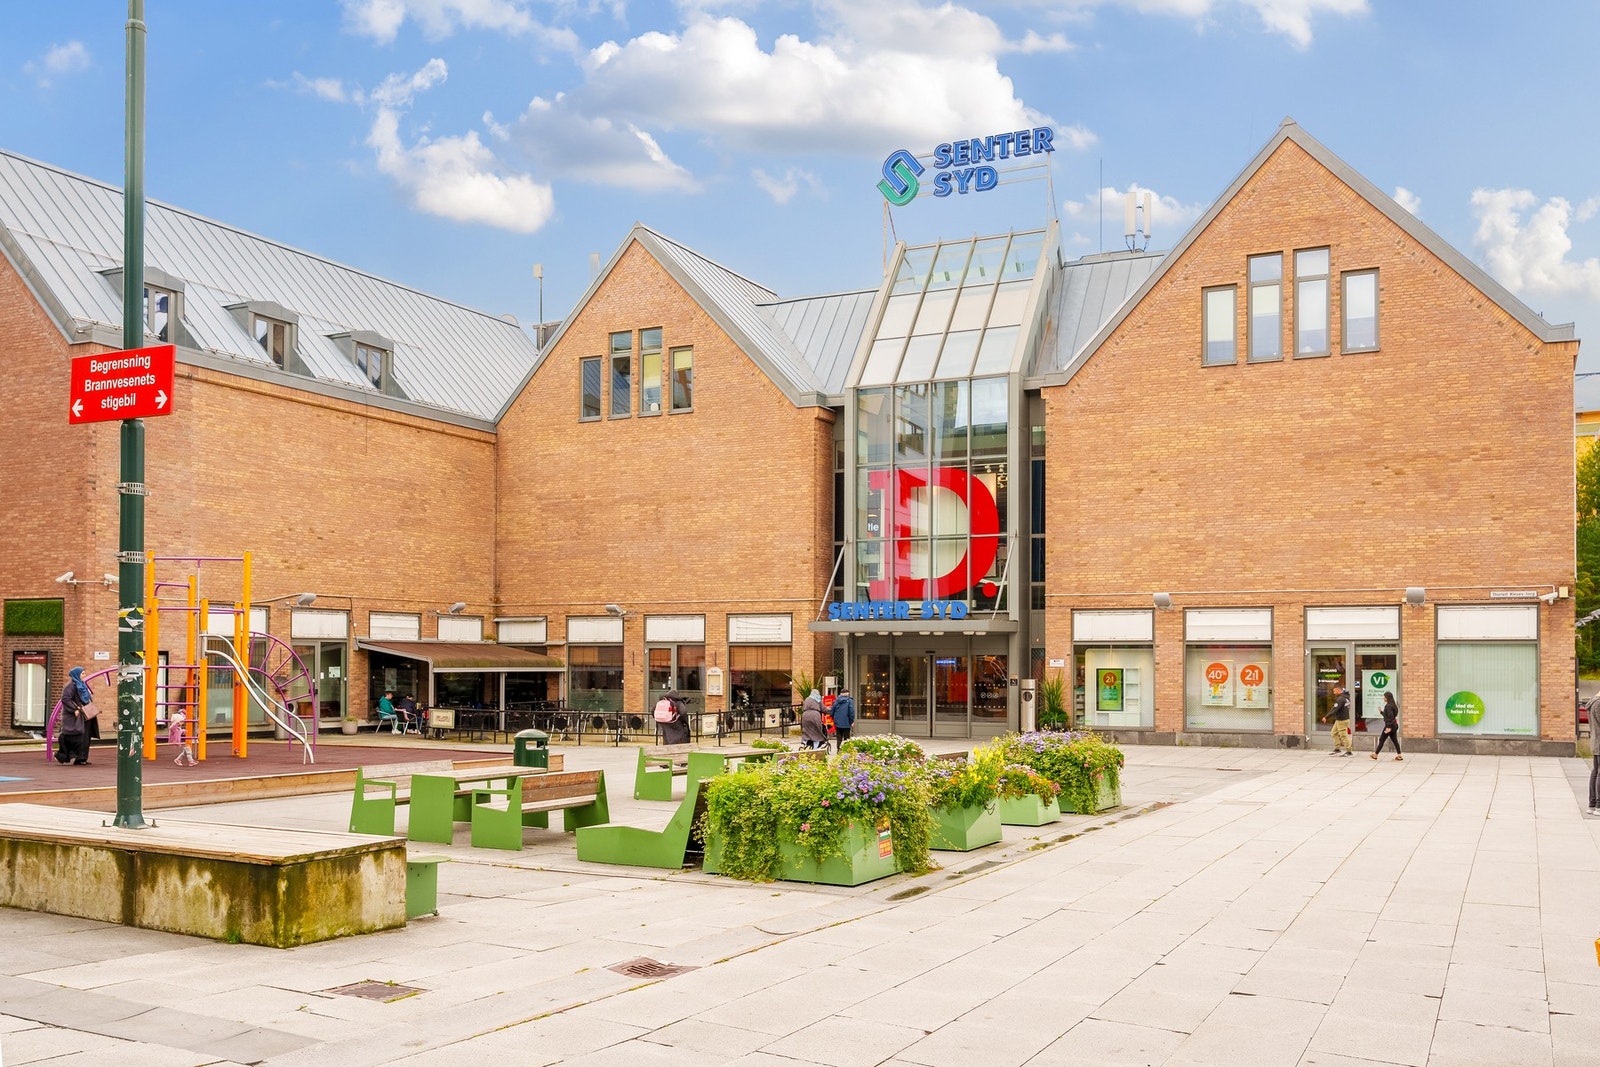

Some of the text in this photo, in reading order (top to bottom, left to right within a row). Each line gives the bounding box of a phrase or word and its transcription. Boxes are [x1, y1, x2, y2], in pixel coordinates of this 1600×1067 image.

[933, 126, 1055, 169] SENTER
[933, 165, 999, 197] SYD
[90, 355, 151, 374] Begrensning
[84, 374, 156, 392] Brannvesenets
[101, 393, 136, 410] stigebil
[827, 600, 968, 620] SENTER SYD
